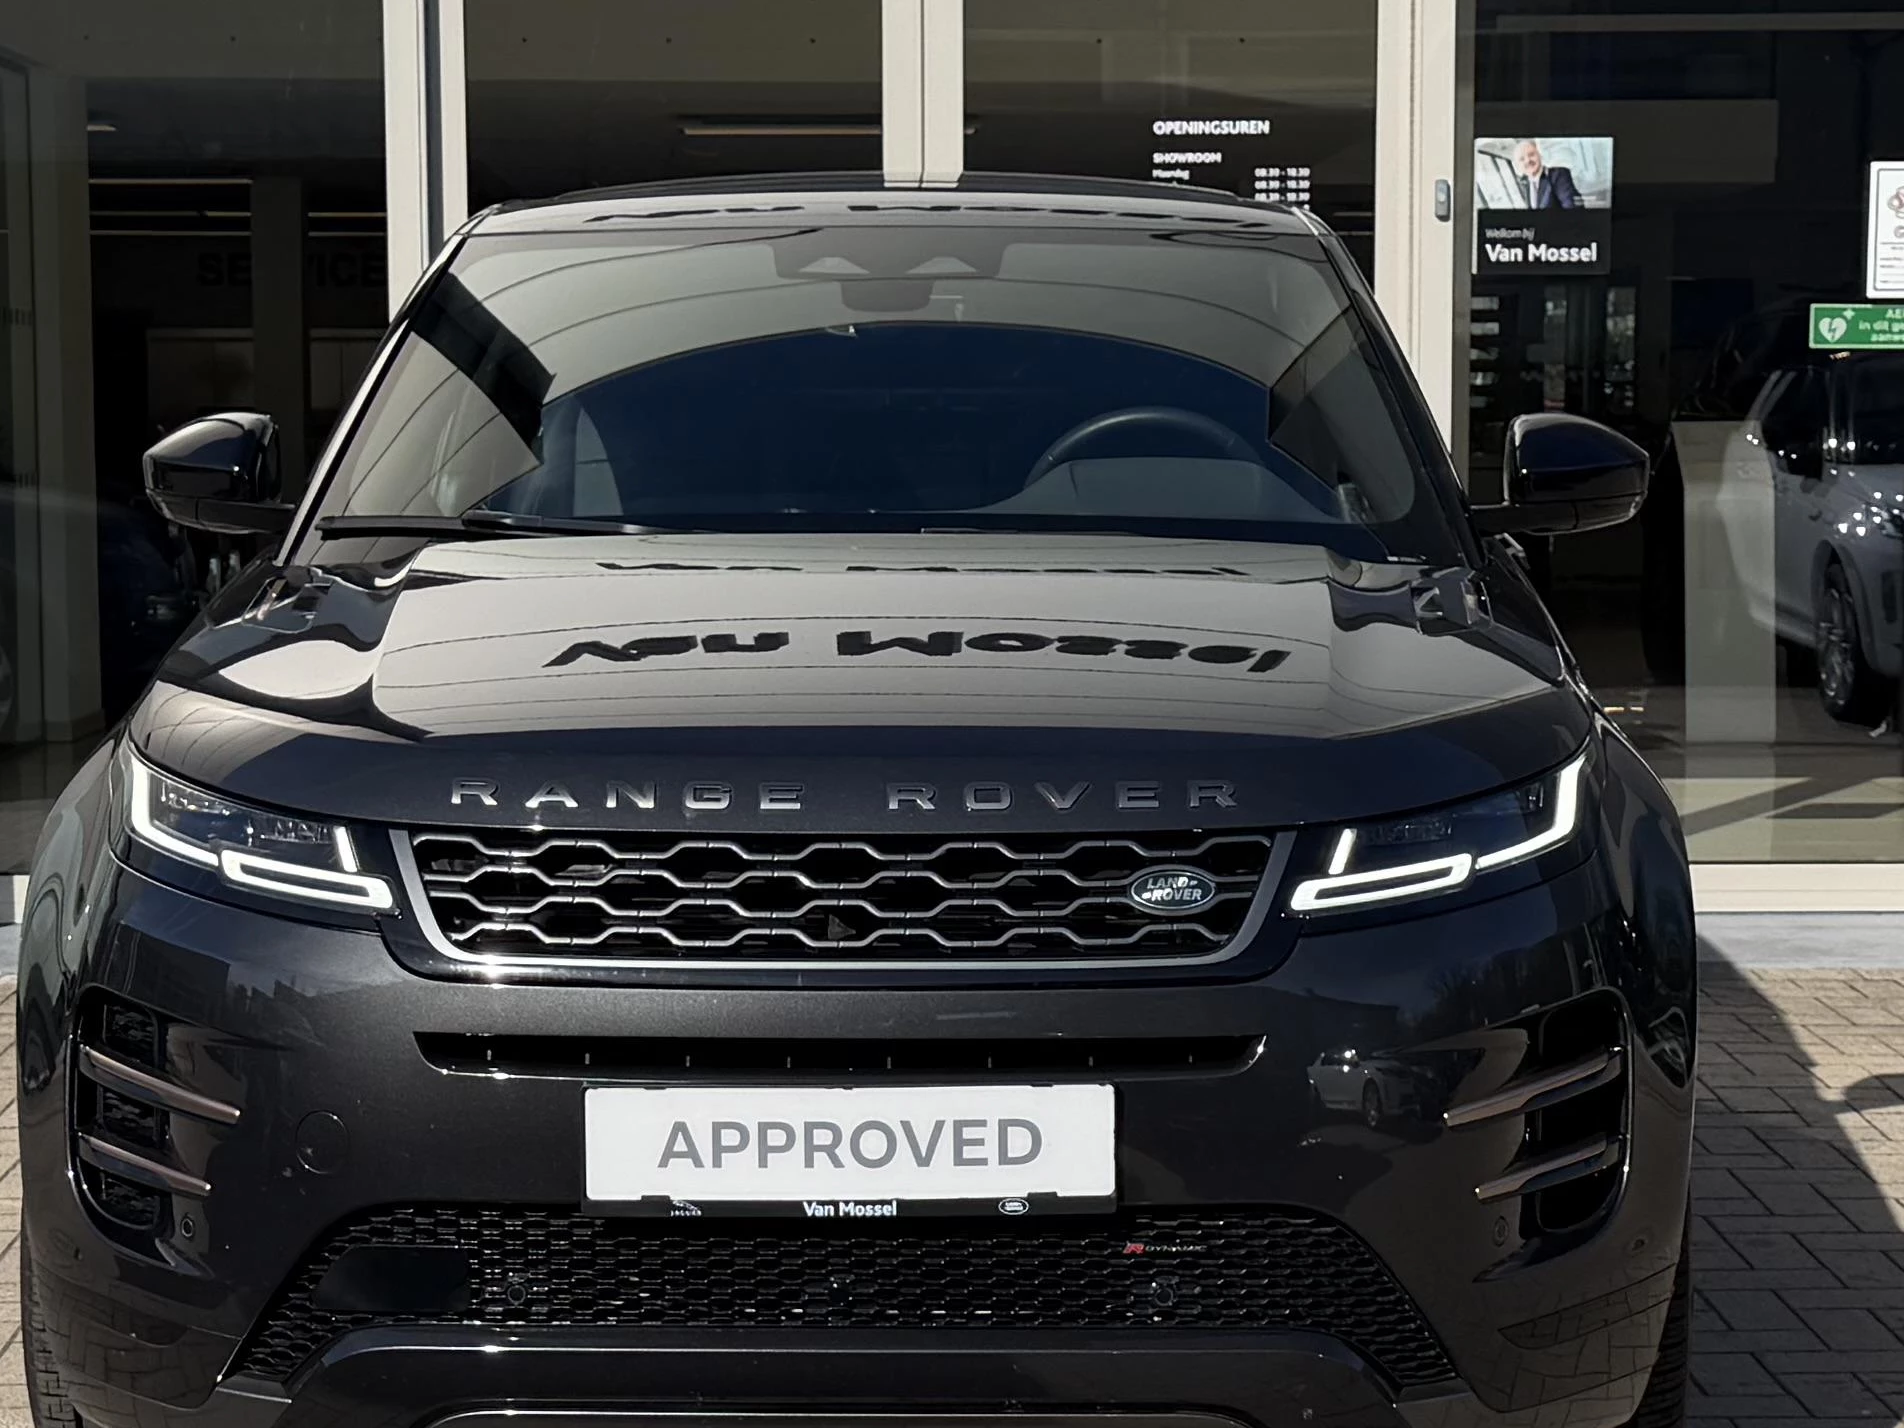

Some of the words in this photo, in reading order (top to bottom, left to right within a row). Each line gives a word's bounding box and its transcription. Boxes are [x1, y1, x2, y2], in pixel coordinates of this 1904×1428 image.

[1152, 120, 1271, 136] OPENINGSUREN
[1153, 152, 1222, 164] SHOWROOM
[1485, 227, 1521, 239] Welkom
[1485, 243, 1523, 262] Van
[1528, 241, 1597, 262] Mossel
[450, 777, 805, 811] RANGE
[887, 779, 1238, 811] ROVER
[657, 1117, 1044, 1170] APPROVED
[802, 1200, 835, 1217] Van
[839, 1199, 897, 1217] Mossel
